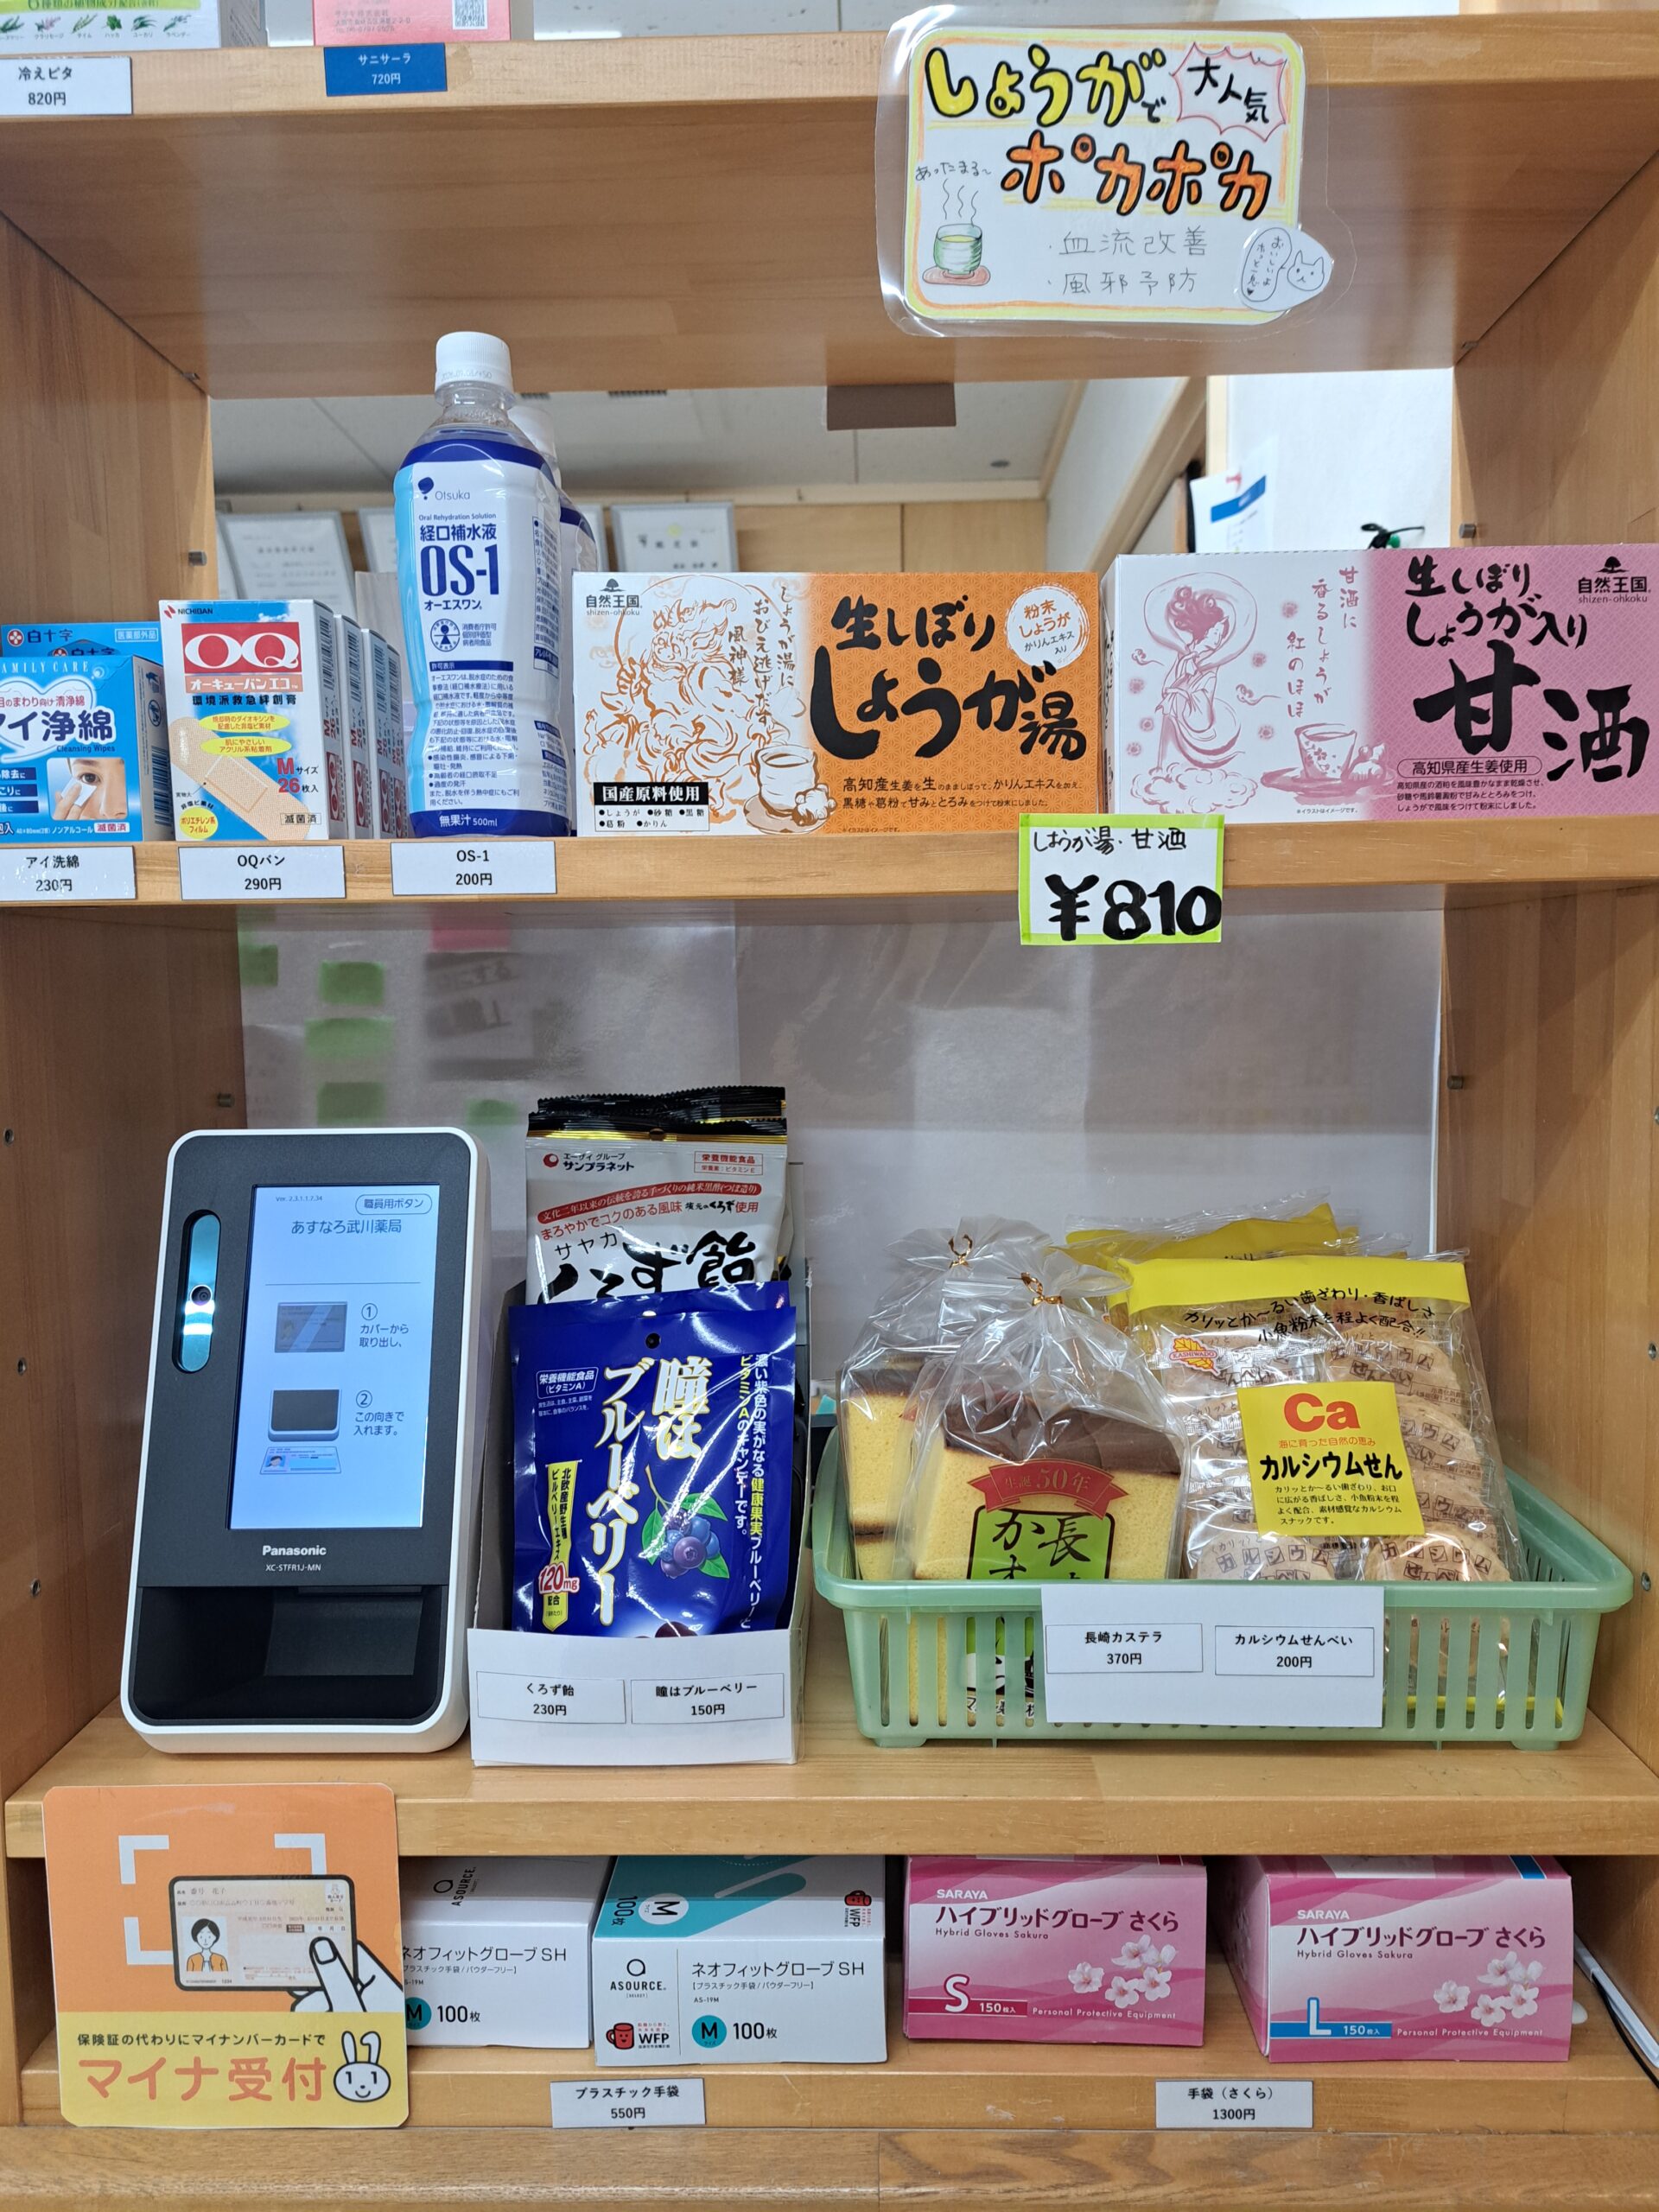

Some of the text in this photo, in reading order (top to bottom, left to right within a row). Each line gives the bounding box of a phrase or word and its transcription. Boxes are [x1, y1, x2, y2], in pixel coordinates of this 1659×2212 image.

[358, 52, 411, 66] サニサーラ
[18, 67, 73, 81] 冷えピタ
[372, 73, 401, 85] 720円
[925, 44, 1167, 127] しょうがで
[1187, 57, 1270, 124] 大人気
[28, 92, 67, 106] 820円
[1001, 130, 1272, 220] ポカポカ
[435, 490, 471, 501] Otsuka
[420, 523, 498, 542] 経口補水液
[420, 543, 499, 597] OS-1
[1405, 554, 1530, 597] 生しぼり
[1578, 576, 1648, 594] 自然王国
[586, 594, 640, 608] 自然王国
[1339, 566, 1359, 630] 甘酒に
[1578, 594, 1648, 604] shizen-ohkoku
[424, 599, 481, 612] オーエスワン
[1023, 599, 1058, 619] 粉末
[831, 594, 995, 652] 生しぼり
[1018, 611, 1071, 639] しょうが
[1407, 594, 1587, 650] しょうが入り
[28, 628, 73, 644] 白十字
[118, 630, 157, 641] 医薬部外品
[777, 586, 797, 687] しょうが湯に
[1023, 630, 1075, 652] かりんエキス
[1312, 578, 1333, 705] 香るしょうが
[184, 632, 300, 670] OQ
[53, 660, 89, 673] CARE
[1287, 630, 1306, 719] 紅のほほ
[190, 678, 291, 690] オーキューバンエコ
[192, 694, 297, 706] 環境派救急絆創膏
[810, 645, 1087, 761] しょうが湯
[1413, 639, 1650, 783] 甘酒
[93, 744, 116, 753] Wipes
[1412, 759, 1528, 776] 高知県産生姜使用
[601, 785, 701, 803] 国産原料使用
[653, 808, 673, 817] 砂糖
[685, 808, 704, 817] 黒糖
[439, 813, 498, 827] 無果汁 500ml
[644, 819, 668, 829] かりん
[52, 826, 94, 835] ノンアルコール
[188, 825, 209, 834] フィルム
[26, 855, 80, 868] アイ洗綿
[237, 855, 285, 868] OQバン
[456, 849, 491, 861] OS-1
[35, 879, 73, 893] 230円
[244, 878, 282, 891] 290円
[455, 873, 493, 886] 200円
[1045, 874, 1223, 942] ¥810
[595, 1152, 625, 1160] グループ
[563, 1160, 635, 1172] サンプラネット
[364, 1198, 424, 1209] 職員用ボタン
[291, 1218, 402, 1235] あすなろ武川薬局
[540, 1200, 683, 1241] まろやかでコクのある風味
[554, 1230, 618, 1262] サヤカ
[359, 1324, 410, 1335] カバーから
[359, 1337, 402, 1348] 取り出し、
[1172, 1350, 1216, 1360] KASHIWADO
[539, 1370, 595, 1385] 栄養機能食品
[652, 1355, 713, 1460] 瞳は
[1283, 1392, 1362, 1433] Ca
[354, 1411, 404, 1422] この向きで
[353, 1425, 399, 1436] 入れます。
[1278, 1436, 1376, 1450] 海に育った自然の恵み
[1259, 1450, 1404, 1481] カルシウムせん
[586, 1357, 655, 1626] ブルーベリー
[1280, 1516, 1337, 1526] スナックです。
[262, 1545, 327, 1556] Panasonic
[539, 1563, 578, 1592] 120mg
[1084, 1630, 1163, 1645] 長崎カステラ
[1234, 1633, 1353, 1647] カルシウムせんべい
[1106, 1652, 1142, 1666] 370円
[1276, 1655, 1313, 1669] 200円
[526, 1682, 575, 1697] くろず飴
[655, 1682, 758, 1698] 瞳はブルーベリー
[532, 1703, 567, 1716] 230円
[690, 1702, 726, 1716] 150円
[450, 1866, 477, 1907] ASOURCE
[936, 1888, 988, 1900] SARAYA
[935, 1905, 1179, 1933] ハイブリッドグローブ さくら
[1297, 1909, 1350, 1921] SARAYA
[936, 1927, 1049, 1940] Hybrid Gloves Sakura
[1296, 1925, 1547, 1949] ハイブリッドグローブ さくら
[541, 1948, 567, 1961] SH
[1297, 1949, 1414, 1960] Hybrid Gloves Sakura
[691, 1961, 865, 1977] ネオフィットグローブ SH
[609, 1980, 663, 1991] ASOURCE
[943, 1973, 971, 2014] S
[405, 2003, 481, 2023] M 100枚
[1033, 2006, 1177, 2022] Personal Protective Equipment
[1306, 1996, 1332, 2037] L
[701, 2021, 778, 2040] M 100枚
[1396, 2027, 1543, 2039] Personal Protective Equipment
[77, 2032, 326, 2048] 保険証の代わりにマイナンバーカードで
[638, 2032, 670, 2044] WFP
[78, 2055, 327, 2102] マイナ受付
[575, 2085, 679, 2100] プラスチック手袋
[610, 2107, 646, 2120] 550円
[1212, 2107, 1256, 2120] 1300円
